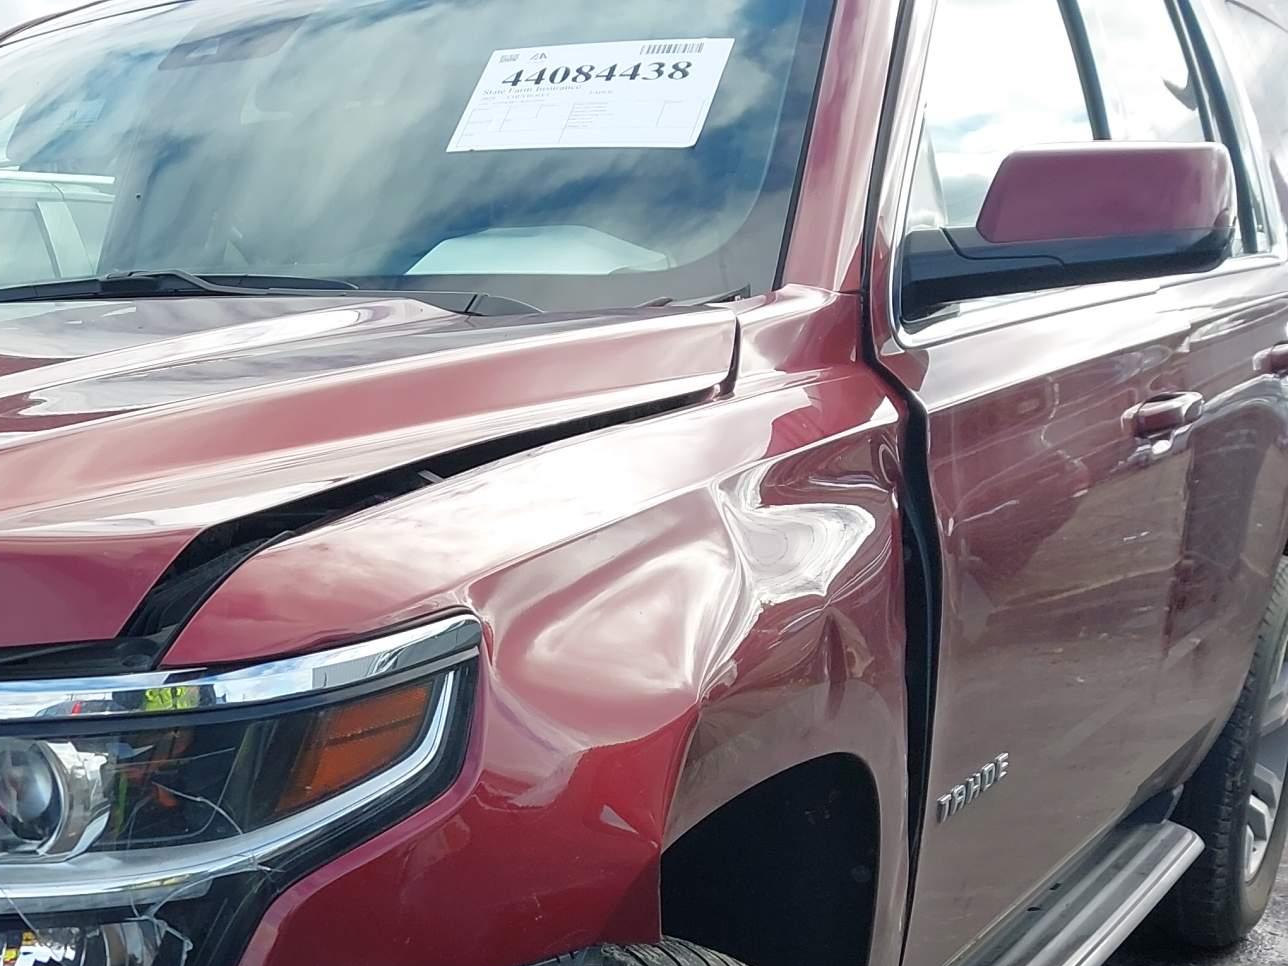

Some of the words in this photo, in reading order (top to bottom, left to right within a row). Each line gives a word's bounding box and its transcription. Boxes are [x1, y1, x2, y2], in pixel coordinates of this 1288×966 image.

[501, 60, 693, 86] 44084438
[482, 88, 505, 96] State
[936, 752, 1009, 824] TAHOE
